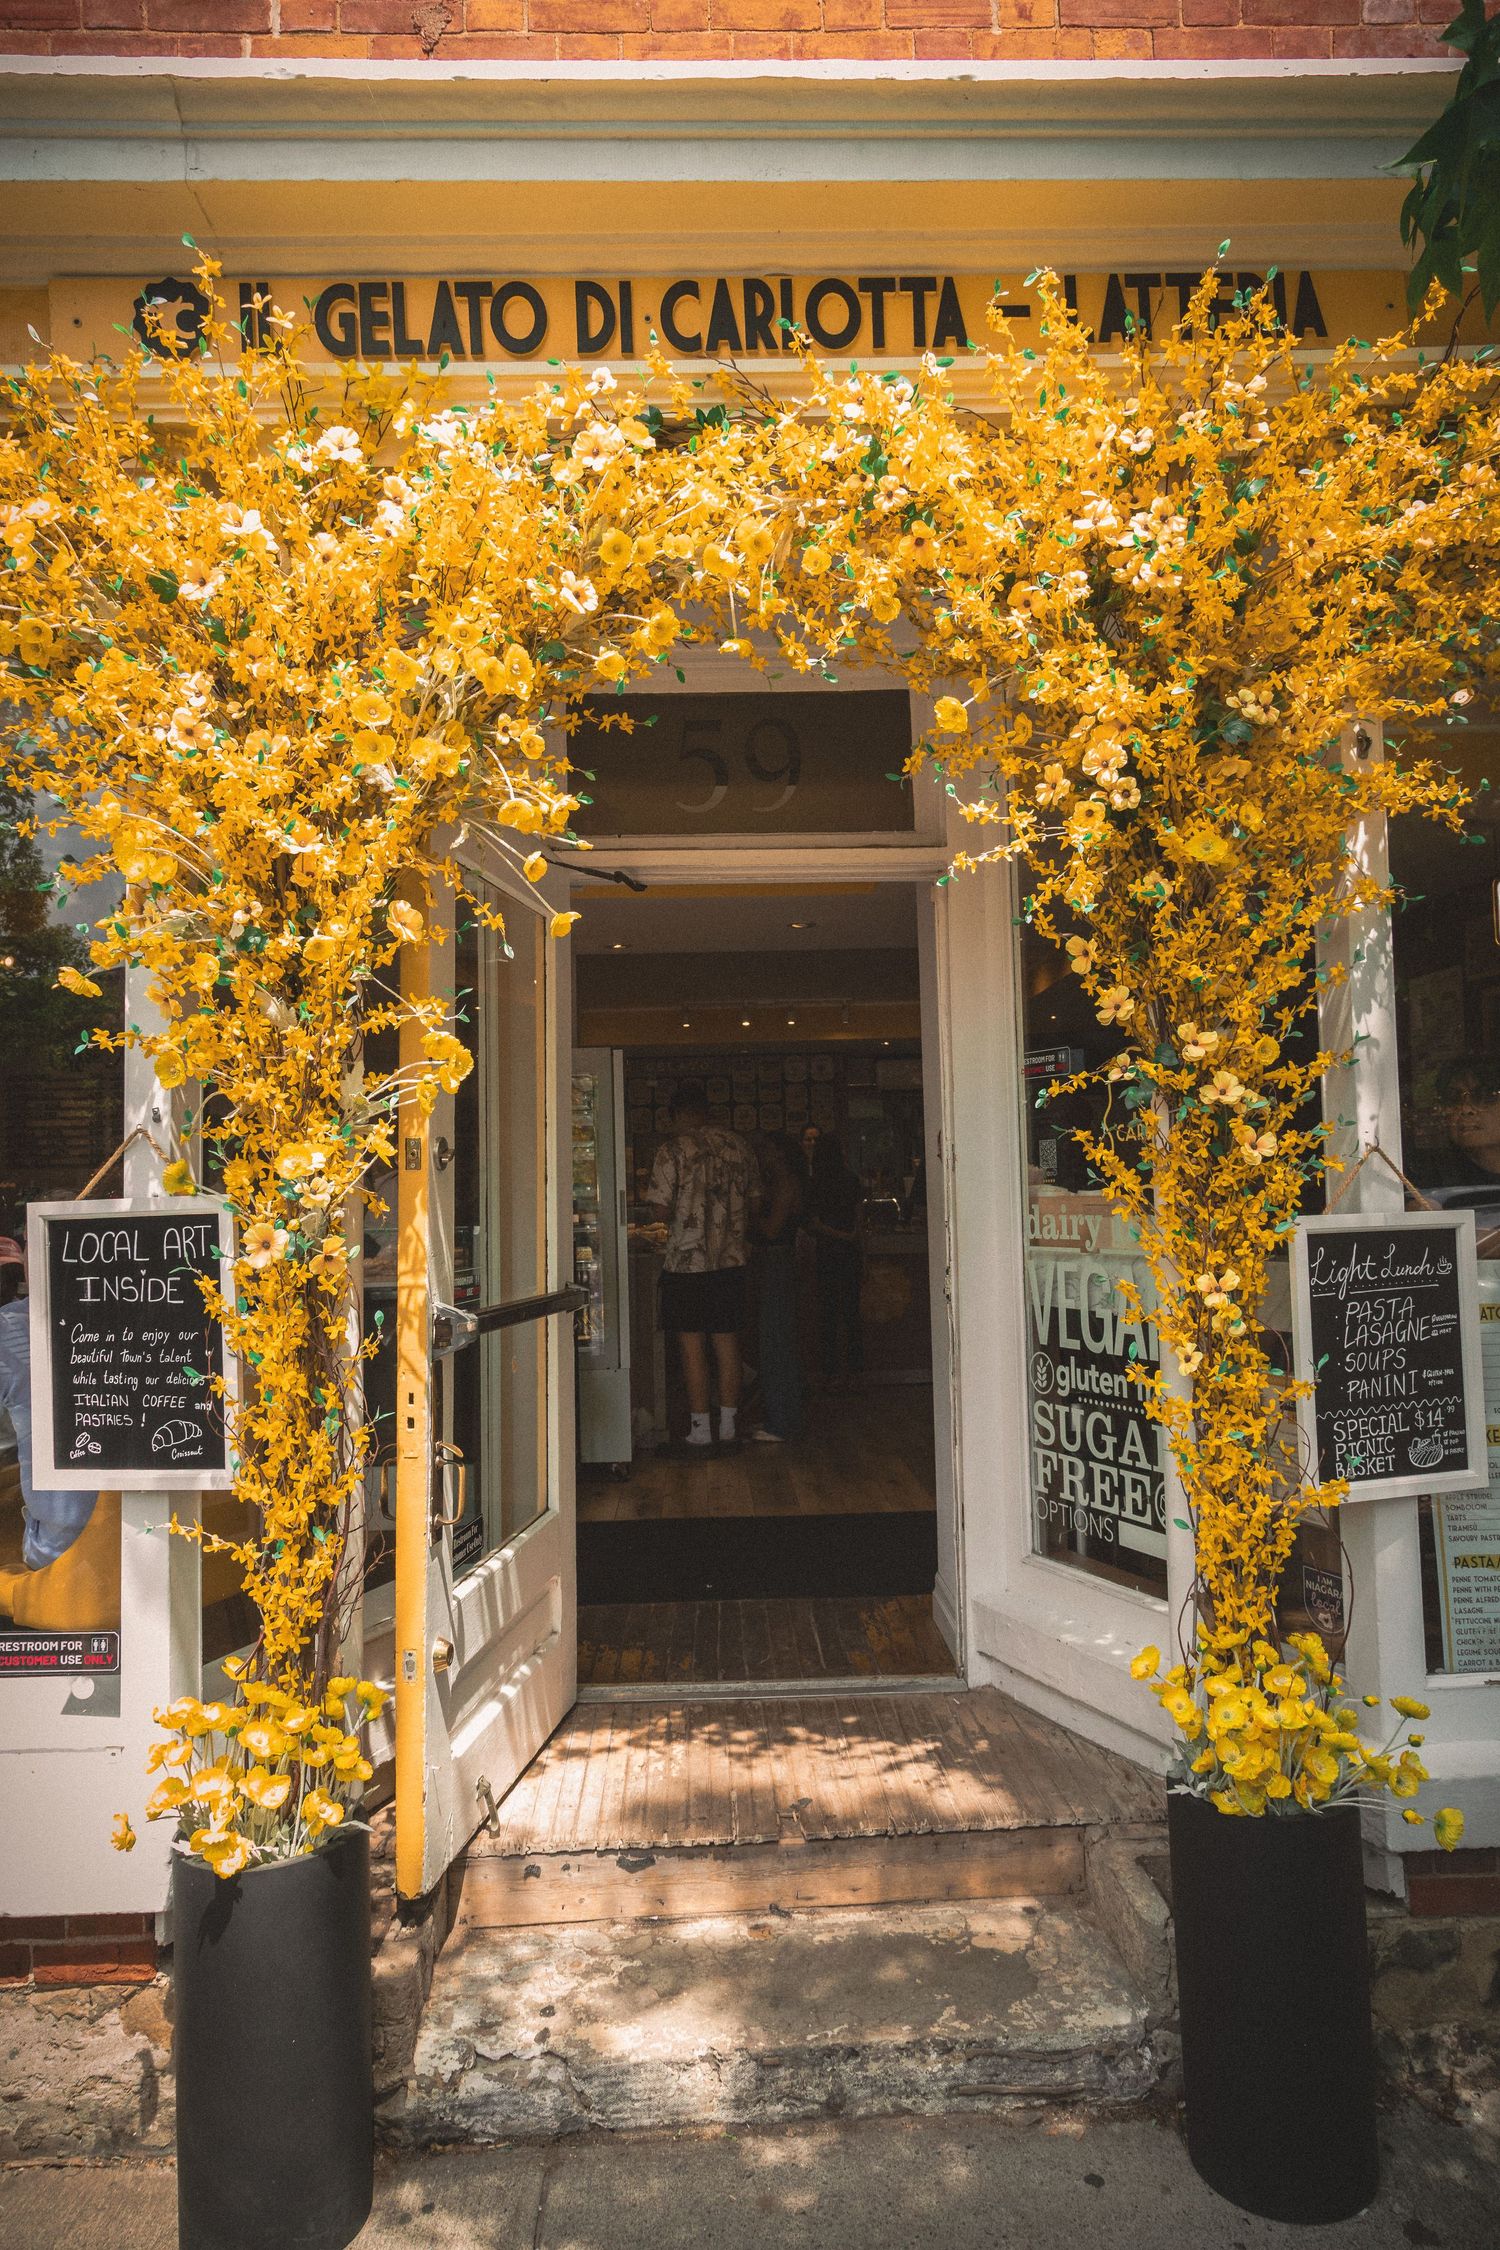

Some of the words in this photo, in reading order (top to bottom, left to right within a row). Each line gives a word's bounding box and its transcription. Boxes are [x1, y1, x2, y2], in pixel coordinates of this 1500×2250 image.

[315, 280, 548, 358] GELATO
[575, 280, 633, 356] DI
[660, 276, 969, 353] CARLOTTA
[674, 718, 800, 813] 59
[1024, 1056, 1045, 1065] ESTROOM
[1027, 1204, 1103, 1251] dairy
[62, 1229, 150, 1264] LOCAL
[163, 1225, 212, 1260] ART
[1310, 1242, 1378, 1300] Light
[1381, 1243, 1435, 1278] Lunch
[1027, 1258, 1160, 1361] VEGA
[1346, 1296, 1415, 1325] PASTA
[71, 1322, 100, 1344] Come
[106, 1330, 115, 1342] in
[122, 1326, 134, 1341] to
[142, 1328, 170, 1346] enjoy
[178, 1331, 198, 1341] our
[1344, 1317, 1431, 1348] LASAGNE
[70, 1346, 113, 1364] beautiful
[159, 1348, 192, 1363] talent
[1344, 1348, 1406, 1372] SOUPS
[72, 1371, 97, 1385] while
[103, 1370, 139, 1391] tasting
[145, 1376, 159, 1385] our
[1056, 1356, 1128, 1399] gluten
[1347, 1370, 1418, 1402] PANINI
[142, 1394, 187, 1408] COFFEE
[194, 1400, 213, 1411] and
[75, 1413, 133, 1427] PASTRIES
[1333, 1412, 1410, 1442] SPECIAL
[69, 1450, 86, 1460] Coffee
[1335, 1436, 1395, 1461] PICNIC
[1335, 1455, 1395, 1479] BASKET
[1033, 1446, 1152, 1525] FREE
[1036, 1496, 1114, 1542] OPTIONS
[0, 1641, 58, 1651] RESTROOM
[61, 1640, 83, 1651] FOR
[0, 1655, 58, 1666] CUSTOMER
[60, 1655, 82, 1665] USE
[83, 1654, 113, 1665] ONLY
[1458, 1659, 1486, 1667] CARROT
